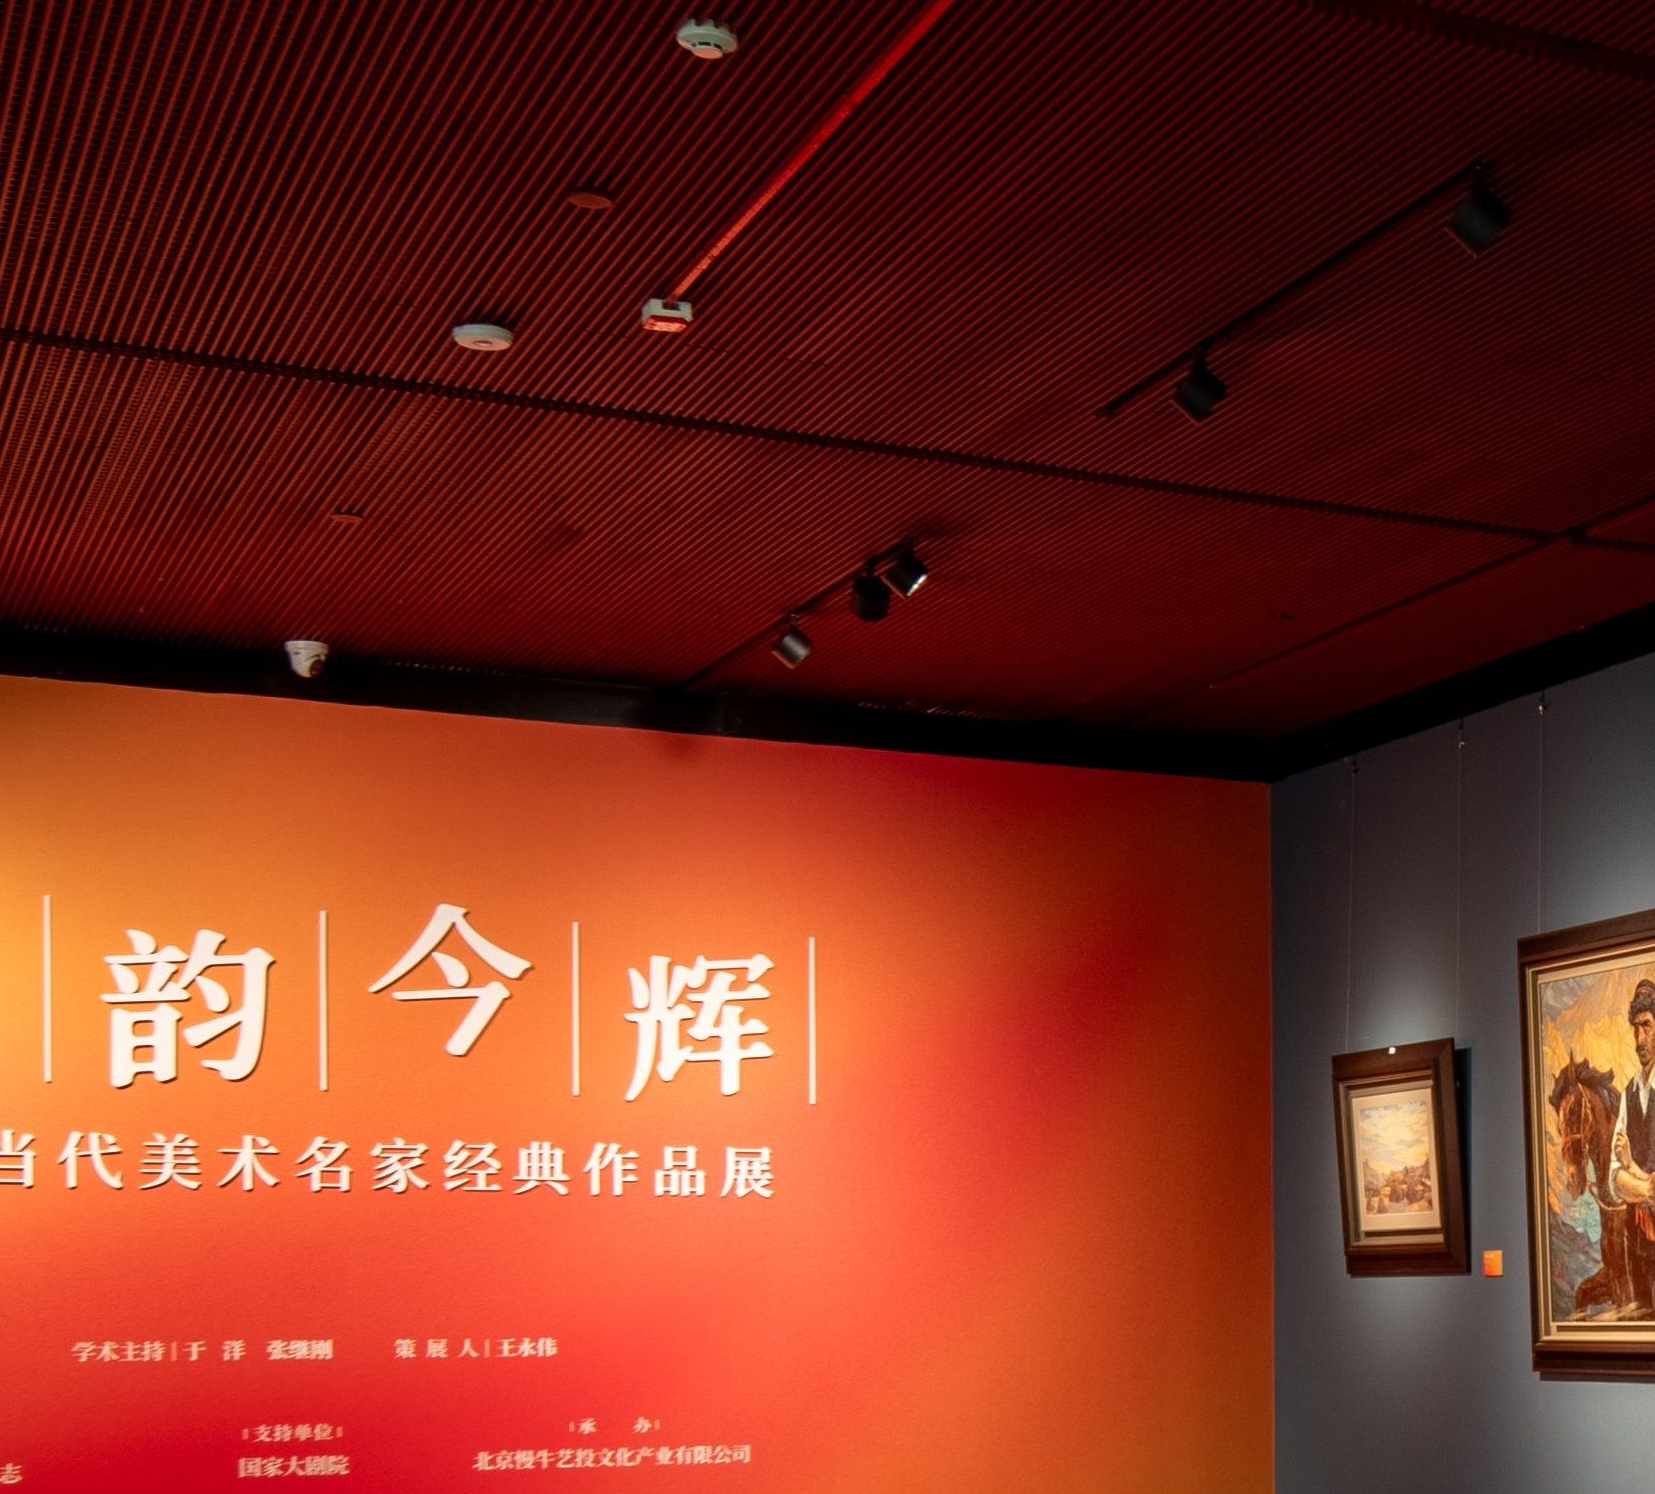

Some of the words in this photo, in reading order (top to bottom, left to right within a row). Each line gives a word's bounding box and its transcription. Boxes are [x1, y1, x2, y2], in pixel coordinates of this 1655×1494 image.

[238, 1454, 350, 1479] 国家大剧院
